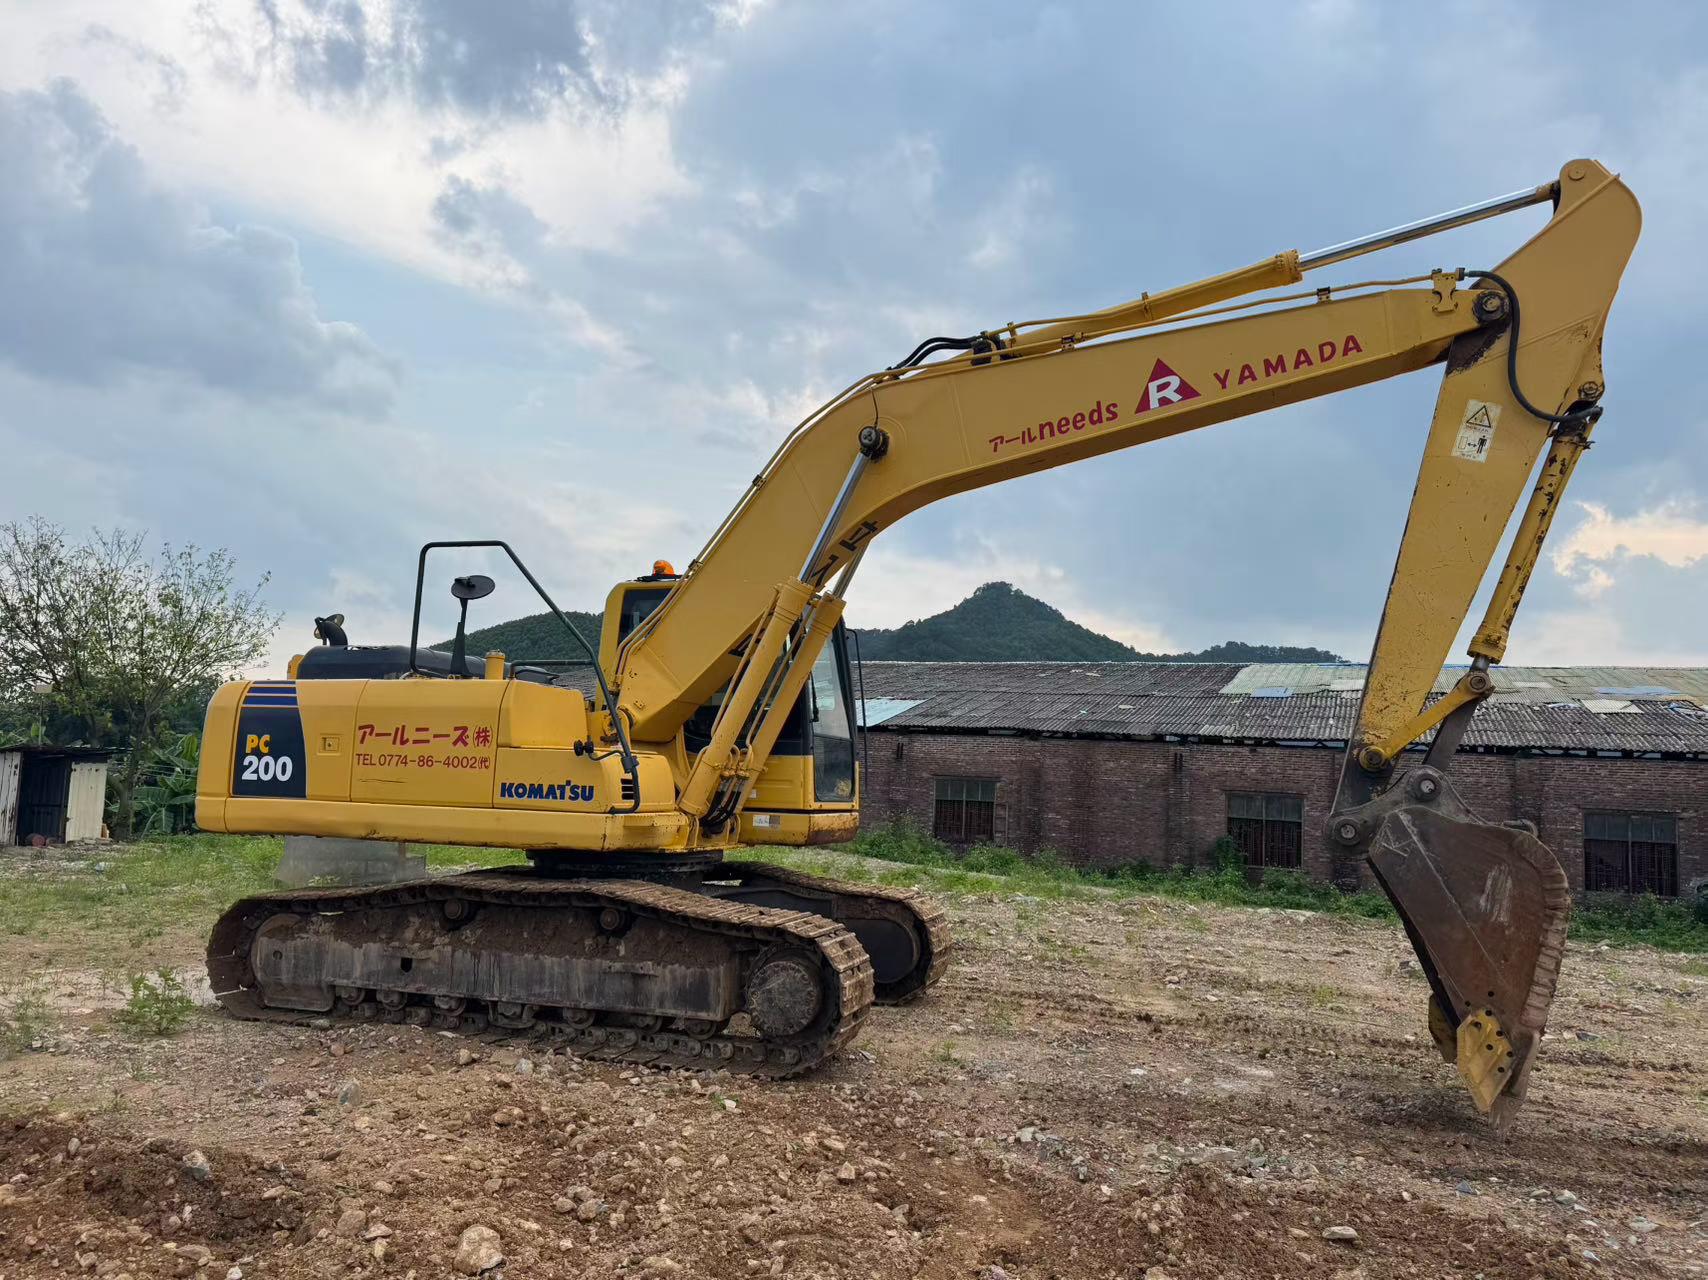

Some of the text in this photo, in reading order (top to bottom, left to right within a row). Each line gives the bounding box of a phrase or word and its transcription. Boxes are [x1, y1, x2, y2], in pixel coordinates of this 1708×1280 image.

[1148, 375, 1183, 409] R
[1213, 334, 1364, 390] YAMADA
[245, 733, 271, 754] PC
[241, 755, 293, 782] 200
[499, 779, 595, 802] KOMATSU
